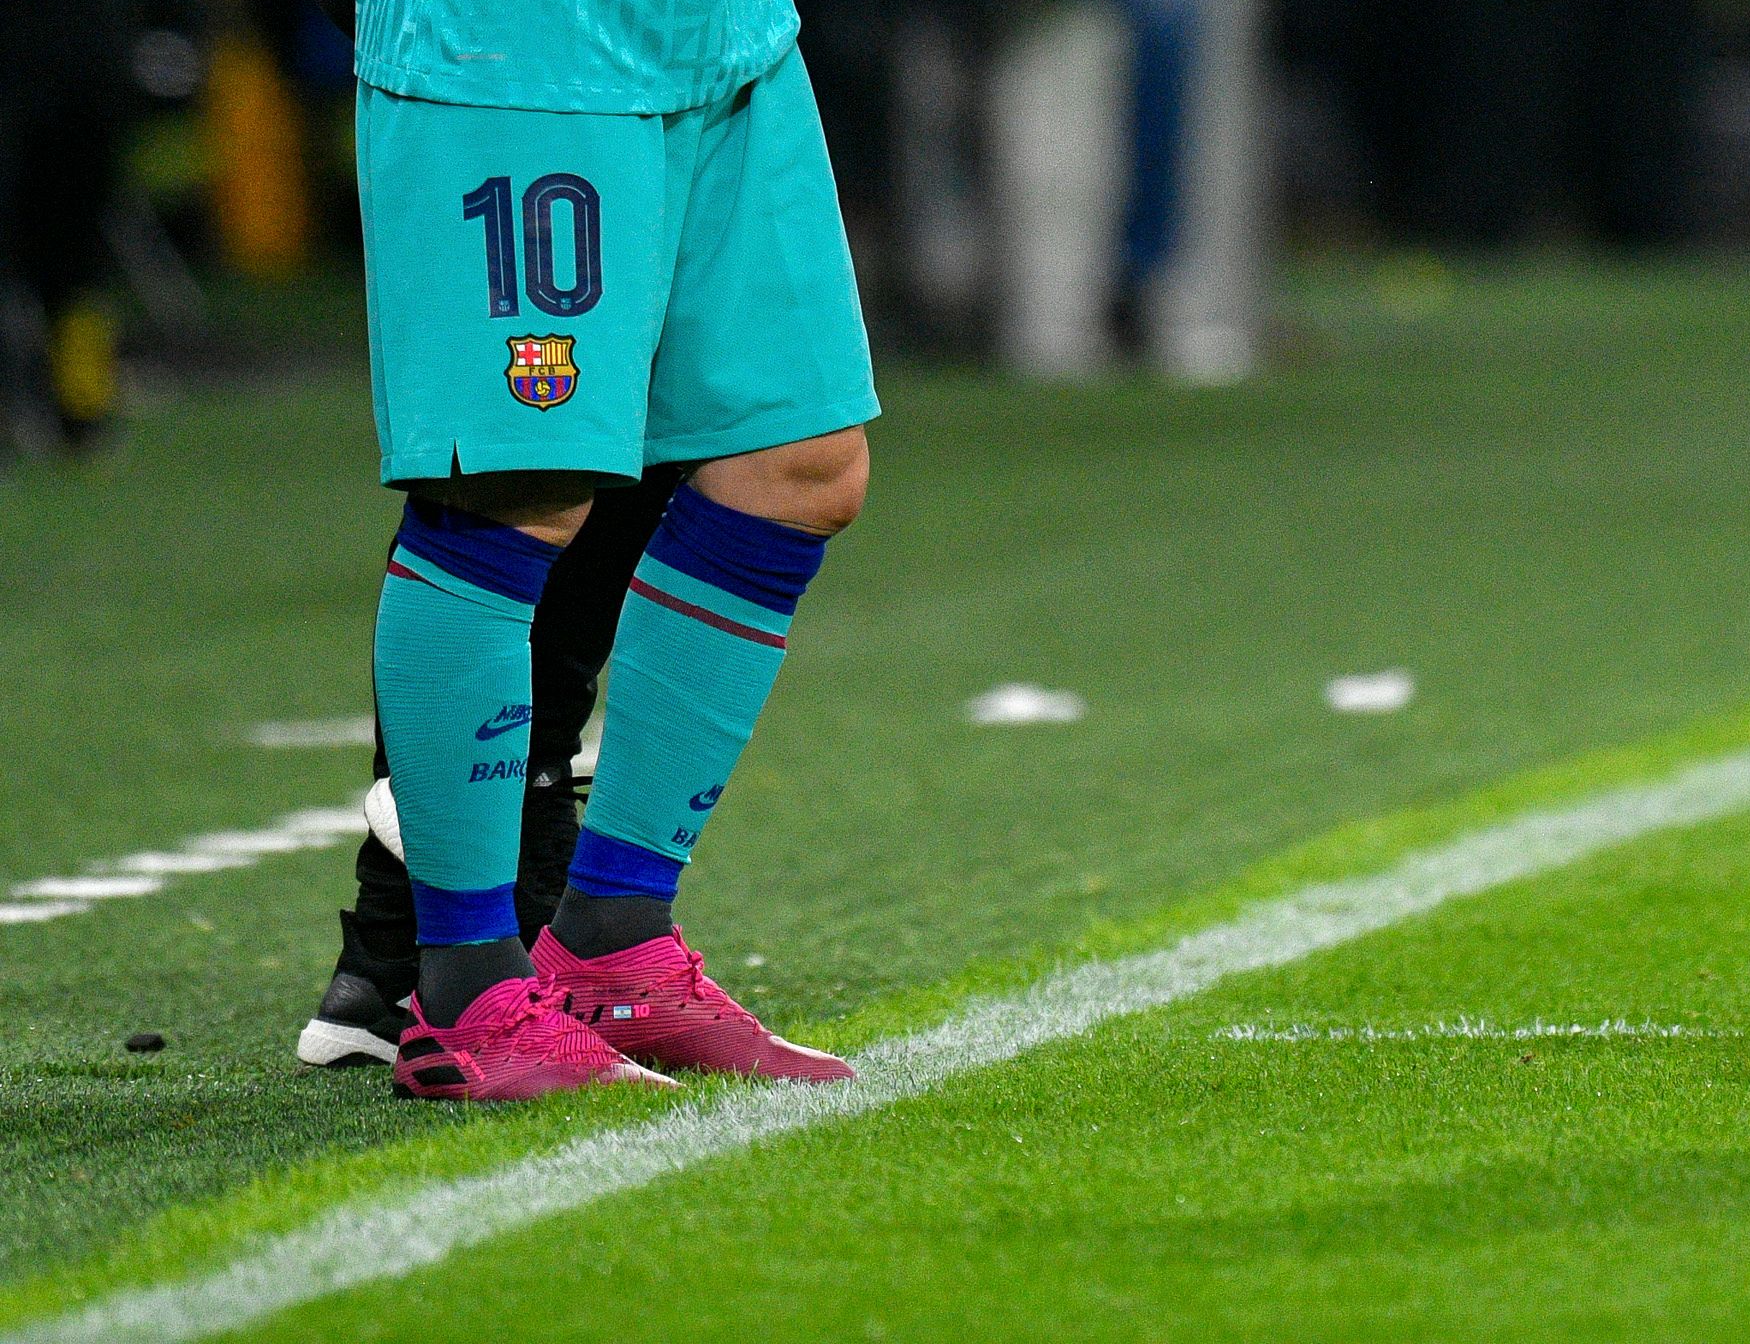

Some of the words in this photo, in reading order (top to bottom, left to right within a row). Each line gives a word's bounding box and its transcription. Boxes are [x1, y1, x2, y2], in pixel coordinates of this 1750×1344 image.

[463, 172, 603, 318] 10
[528, 367, 556, 376] FCB
[633, 1004, 650, 1018] 10
